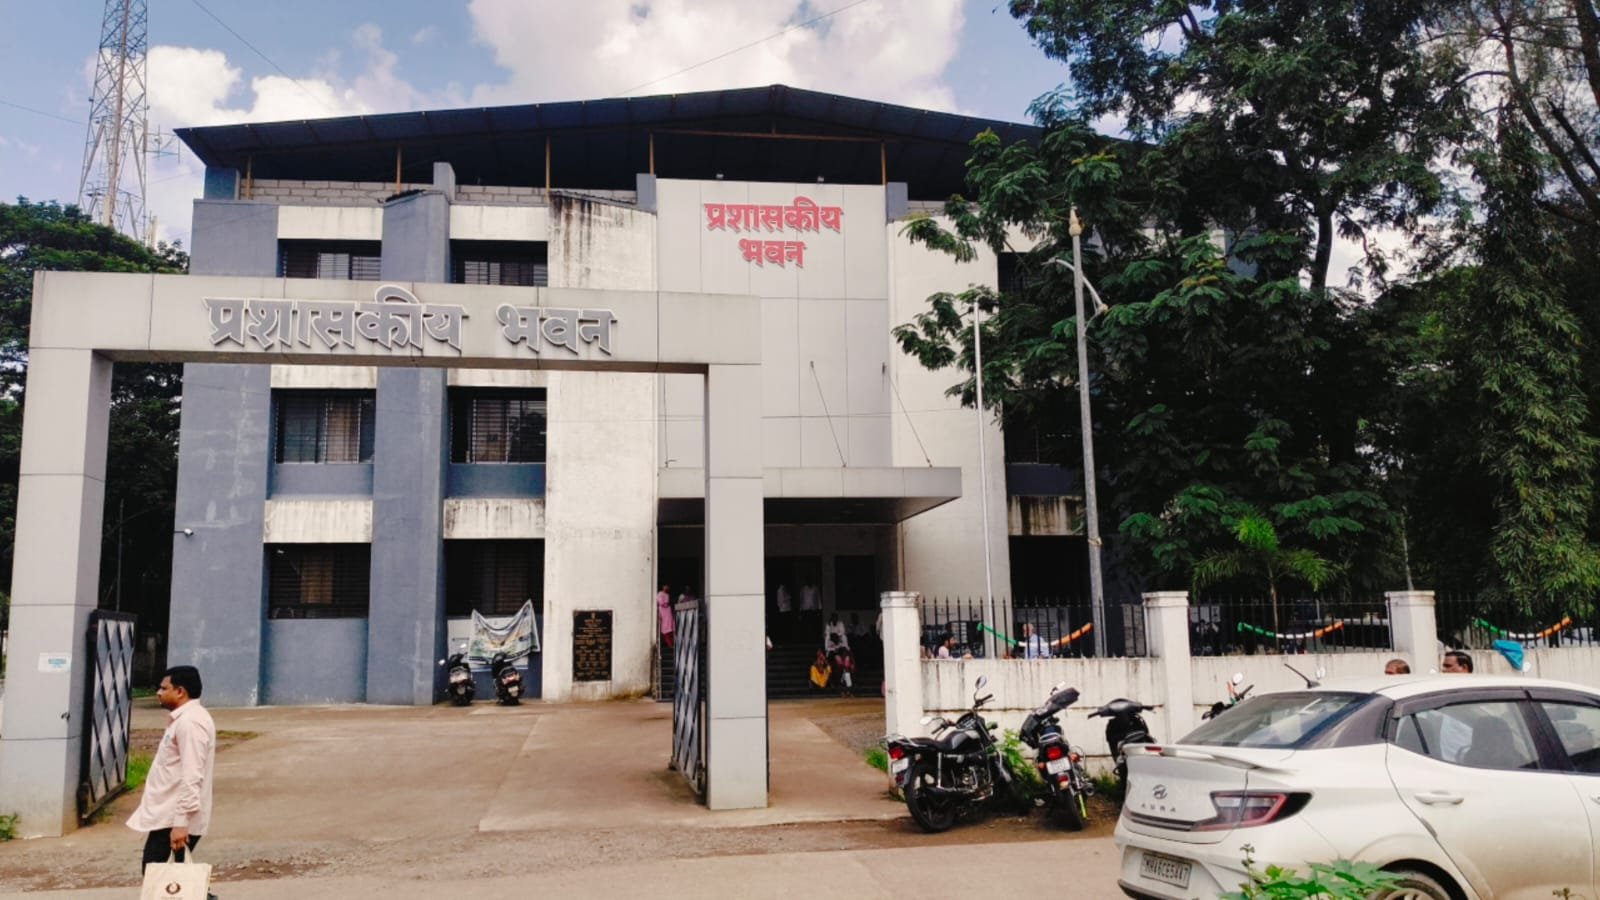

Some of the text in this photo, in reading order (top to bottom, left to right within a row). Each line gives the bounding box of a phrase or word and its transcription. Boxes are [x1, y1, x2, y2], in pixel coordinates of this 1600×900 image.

[703, 196, 843, 233] प्रशासकीय
[738, 238, 806, 269] भवन
[201, 284, 618, 356] प्रशासकीय भवन
[1140, 803, 1176, 813] AURA
